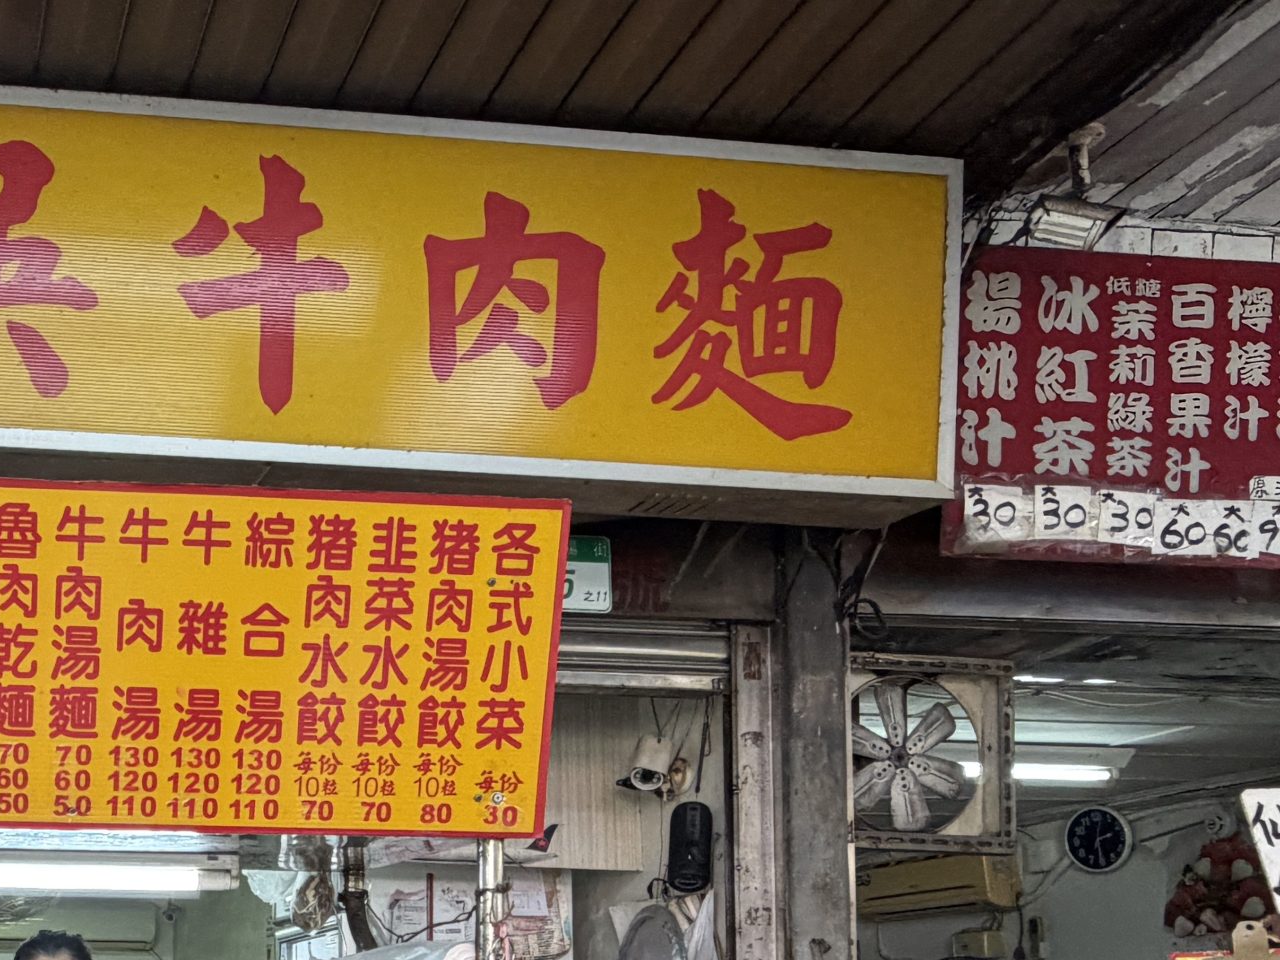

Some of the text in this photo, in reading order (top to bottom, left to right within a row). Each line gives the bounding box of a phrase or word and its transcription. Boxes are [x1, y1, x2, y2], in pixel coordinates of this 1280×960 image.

[1106, 275, 1161, 298] 低糖
[961, 270, 1022, 467] 楊桃汁
[1033, 276, 1100, 476] 冰紅茶
[1223, 286, 1273, 441] 檸檬汁
[1106, 301, 1158, 477] 茉莉綠茶
[1166, 283, 1218, 493] 百香果汁
[1042, 498, 1087, 530] 30
[1110, 500, 1153, 532] 30
[1160, 518, 1207, 550] 60
[583, 590, 608, 602] 之11
[49, 505, 105, 740] 牛肉湯麵
[111, 507, 168, 741] 牛肉湯
[173, 509, 231, 742] 牛雜湯
[235, 512, 295, 744] 綜合湯
[357, 516, 418, 748] 韭菜水餃
[475, 522, 541, 750] 各式小菜
[57, 746, 92, 766] 70
[110, 747, 159, 767] 130
[172, 748, 221, 769] 130
[234, 750, 282, 770] 130
[293, 751, 463, 777] 每份 每份 每份
[54, 771, 91, 791] 60
[109, 771, 158, 792] 120
[169, 773, 220, 794] 120
[233, 774, 280, 795] 120
[293, 776, 457, 798] 10粒 10粒 10粒
[475, 770, 524, 794] 每份
[108, 797, 157, 817] 110
[169, 798, 218, 819] 110
[230, 800, 279, 820] 110
[301, 800, 518, 827] 70 70 80 30
